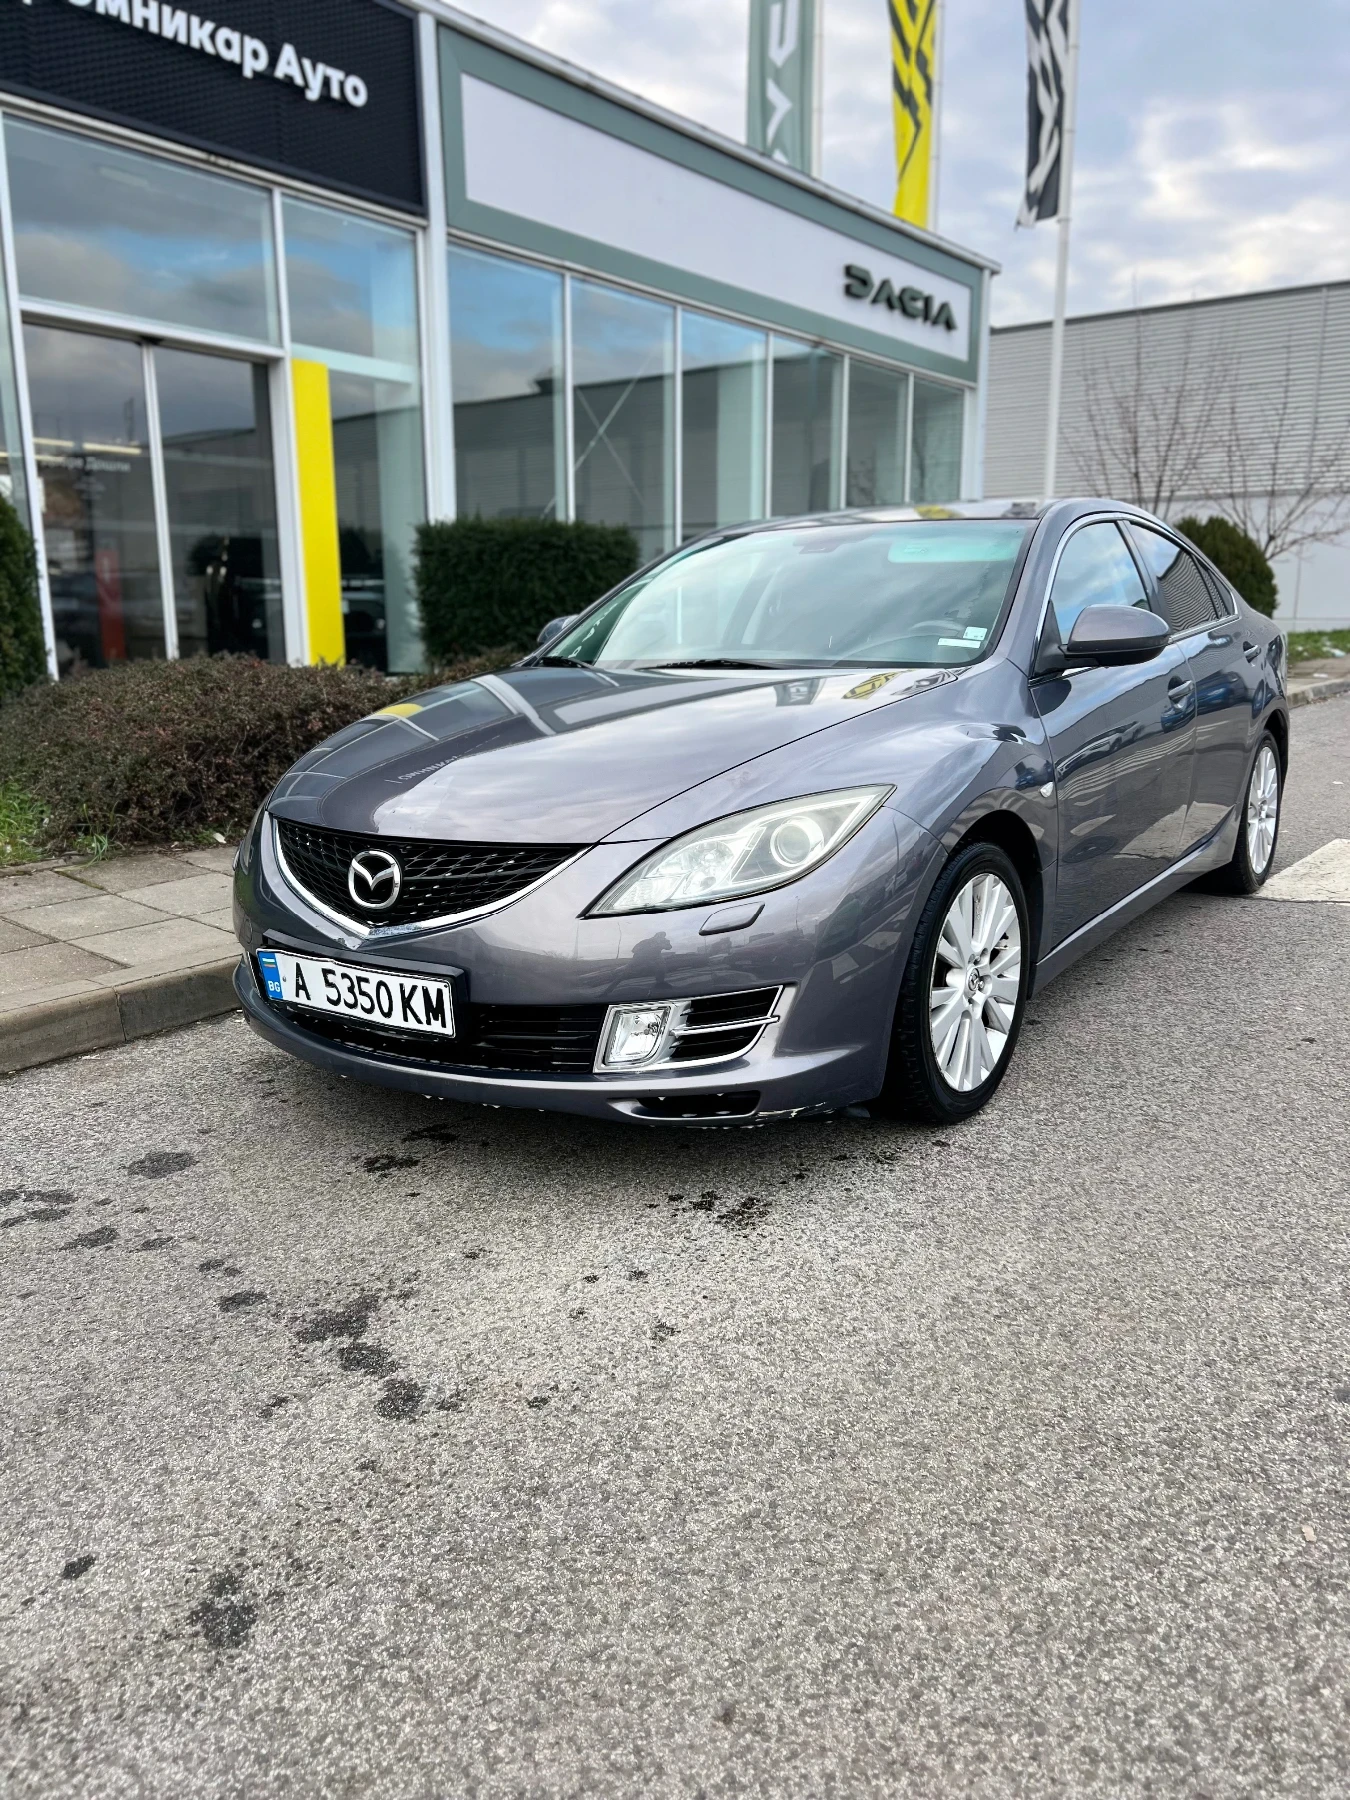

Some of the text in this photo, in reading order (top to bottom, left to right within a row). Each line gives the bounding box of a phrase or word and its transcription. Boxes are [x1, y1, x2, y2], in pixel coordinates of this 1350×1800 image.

[274, 42, 368, 107] Ауто
[843, 264, 957, 331] DACIA
[268, 980, 281, 992] BG
[295, 962, 447, 1029] A 5350 KM
